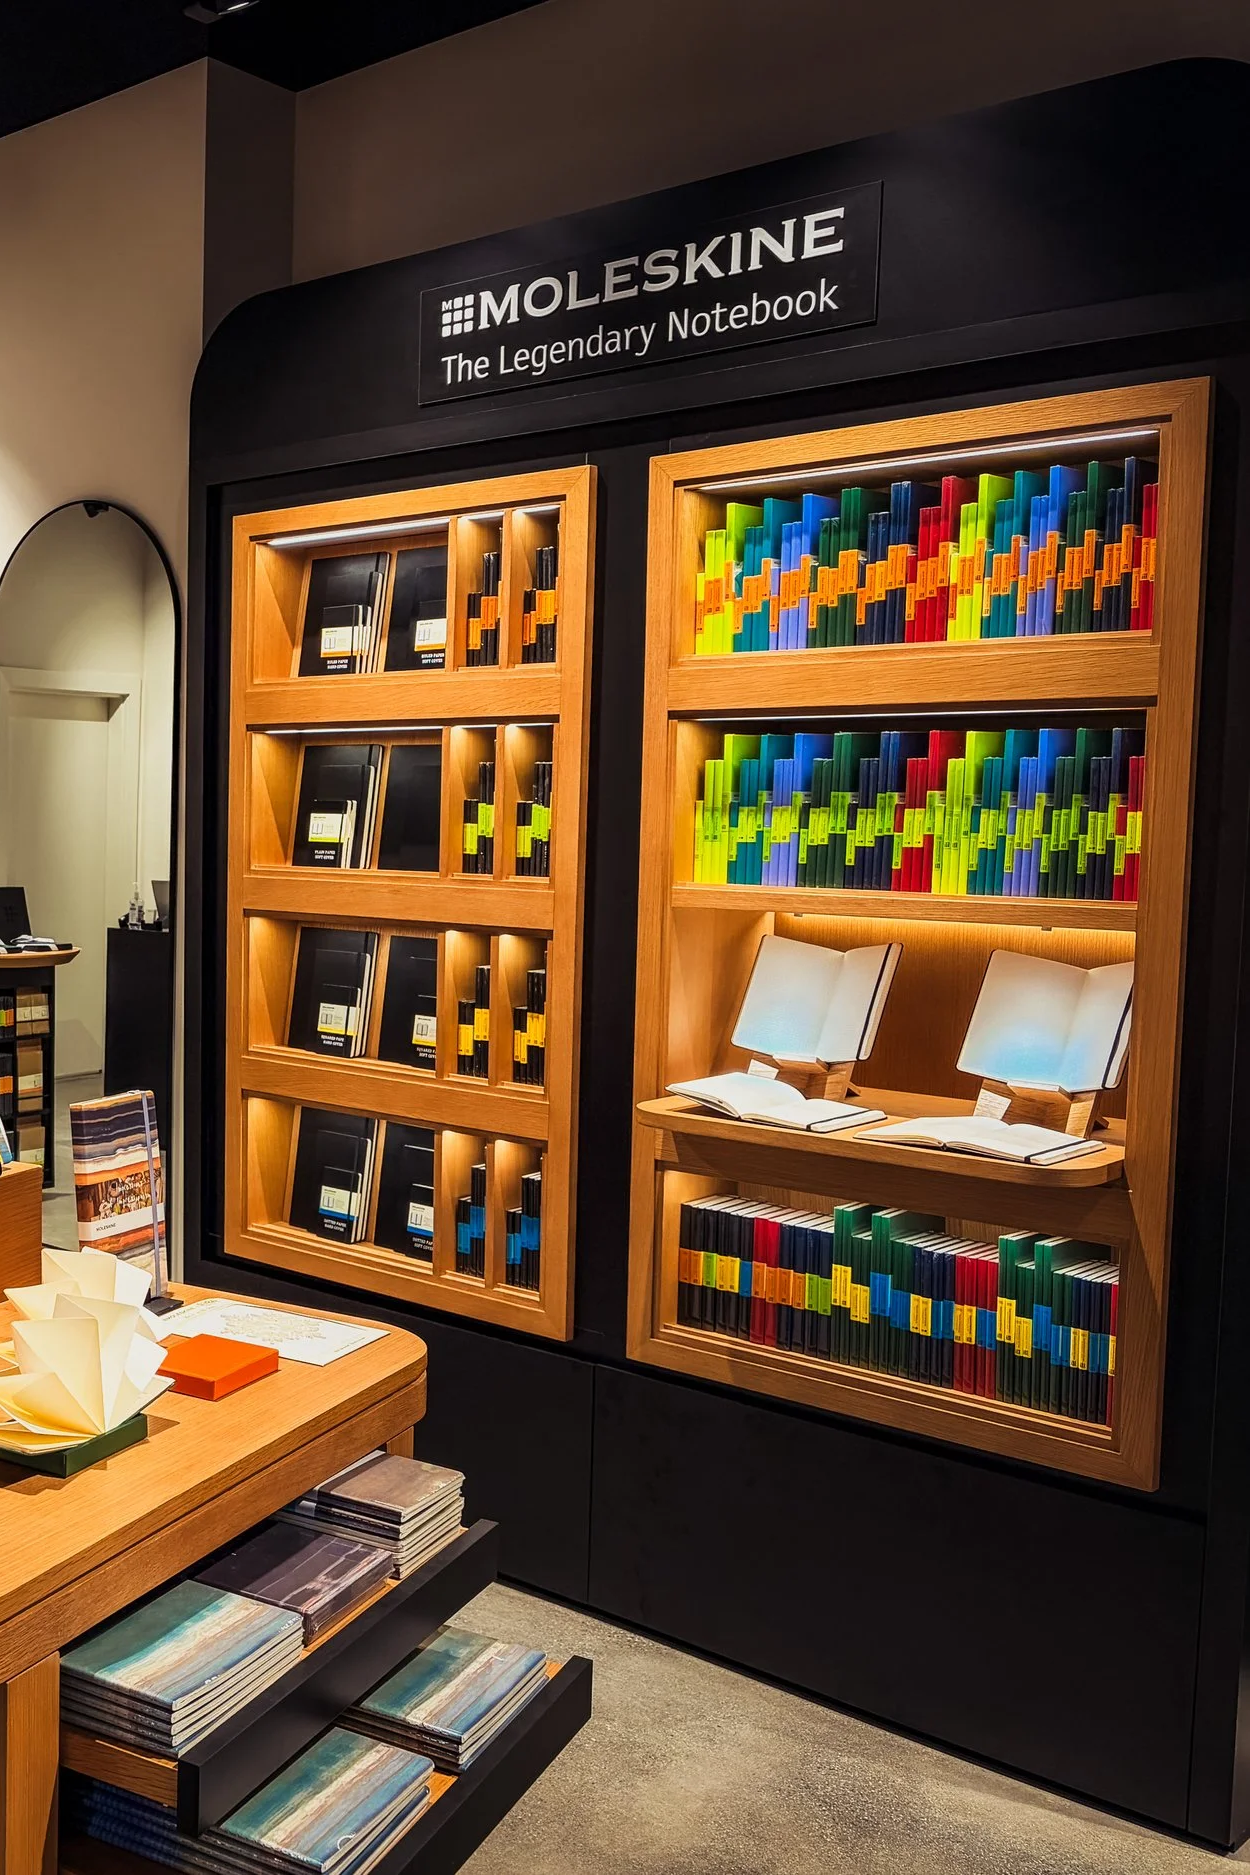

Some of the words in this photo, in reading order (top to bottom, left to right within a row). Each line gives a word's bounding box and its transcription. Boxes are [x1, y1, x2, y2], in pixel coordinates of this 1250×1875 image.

[441, 299, 452, 312] M
[478, 206, 845, 330] MOLESKINE
[441, 351, 489, 385] The
[500, 319, 657, 375] Legendary
[667, 278, 839, 342] Notebook
